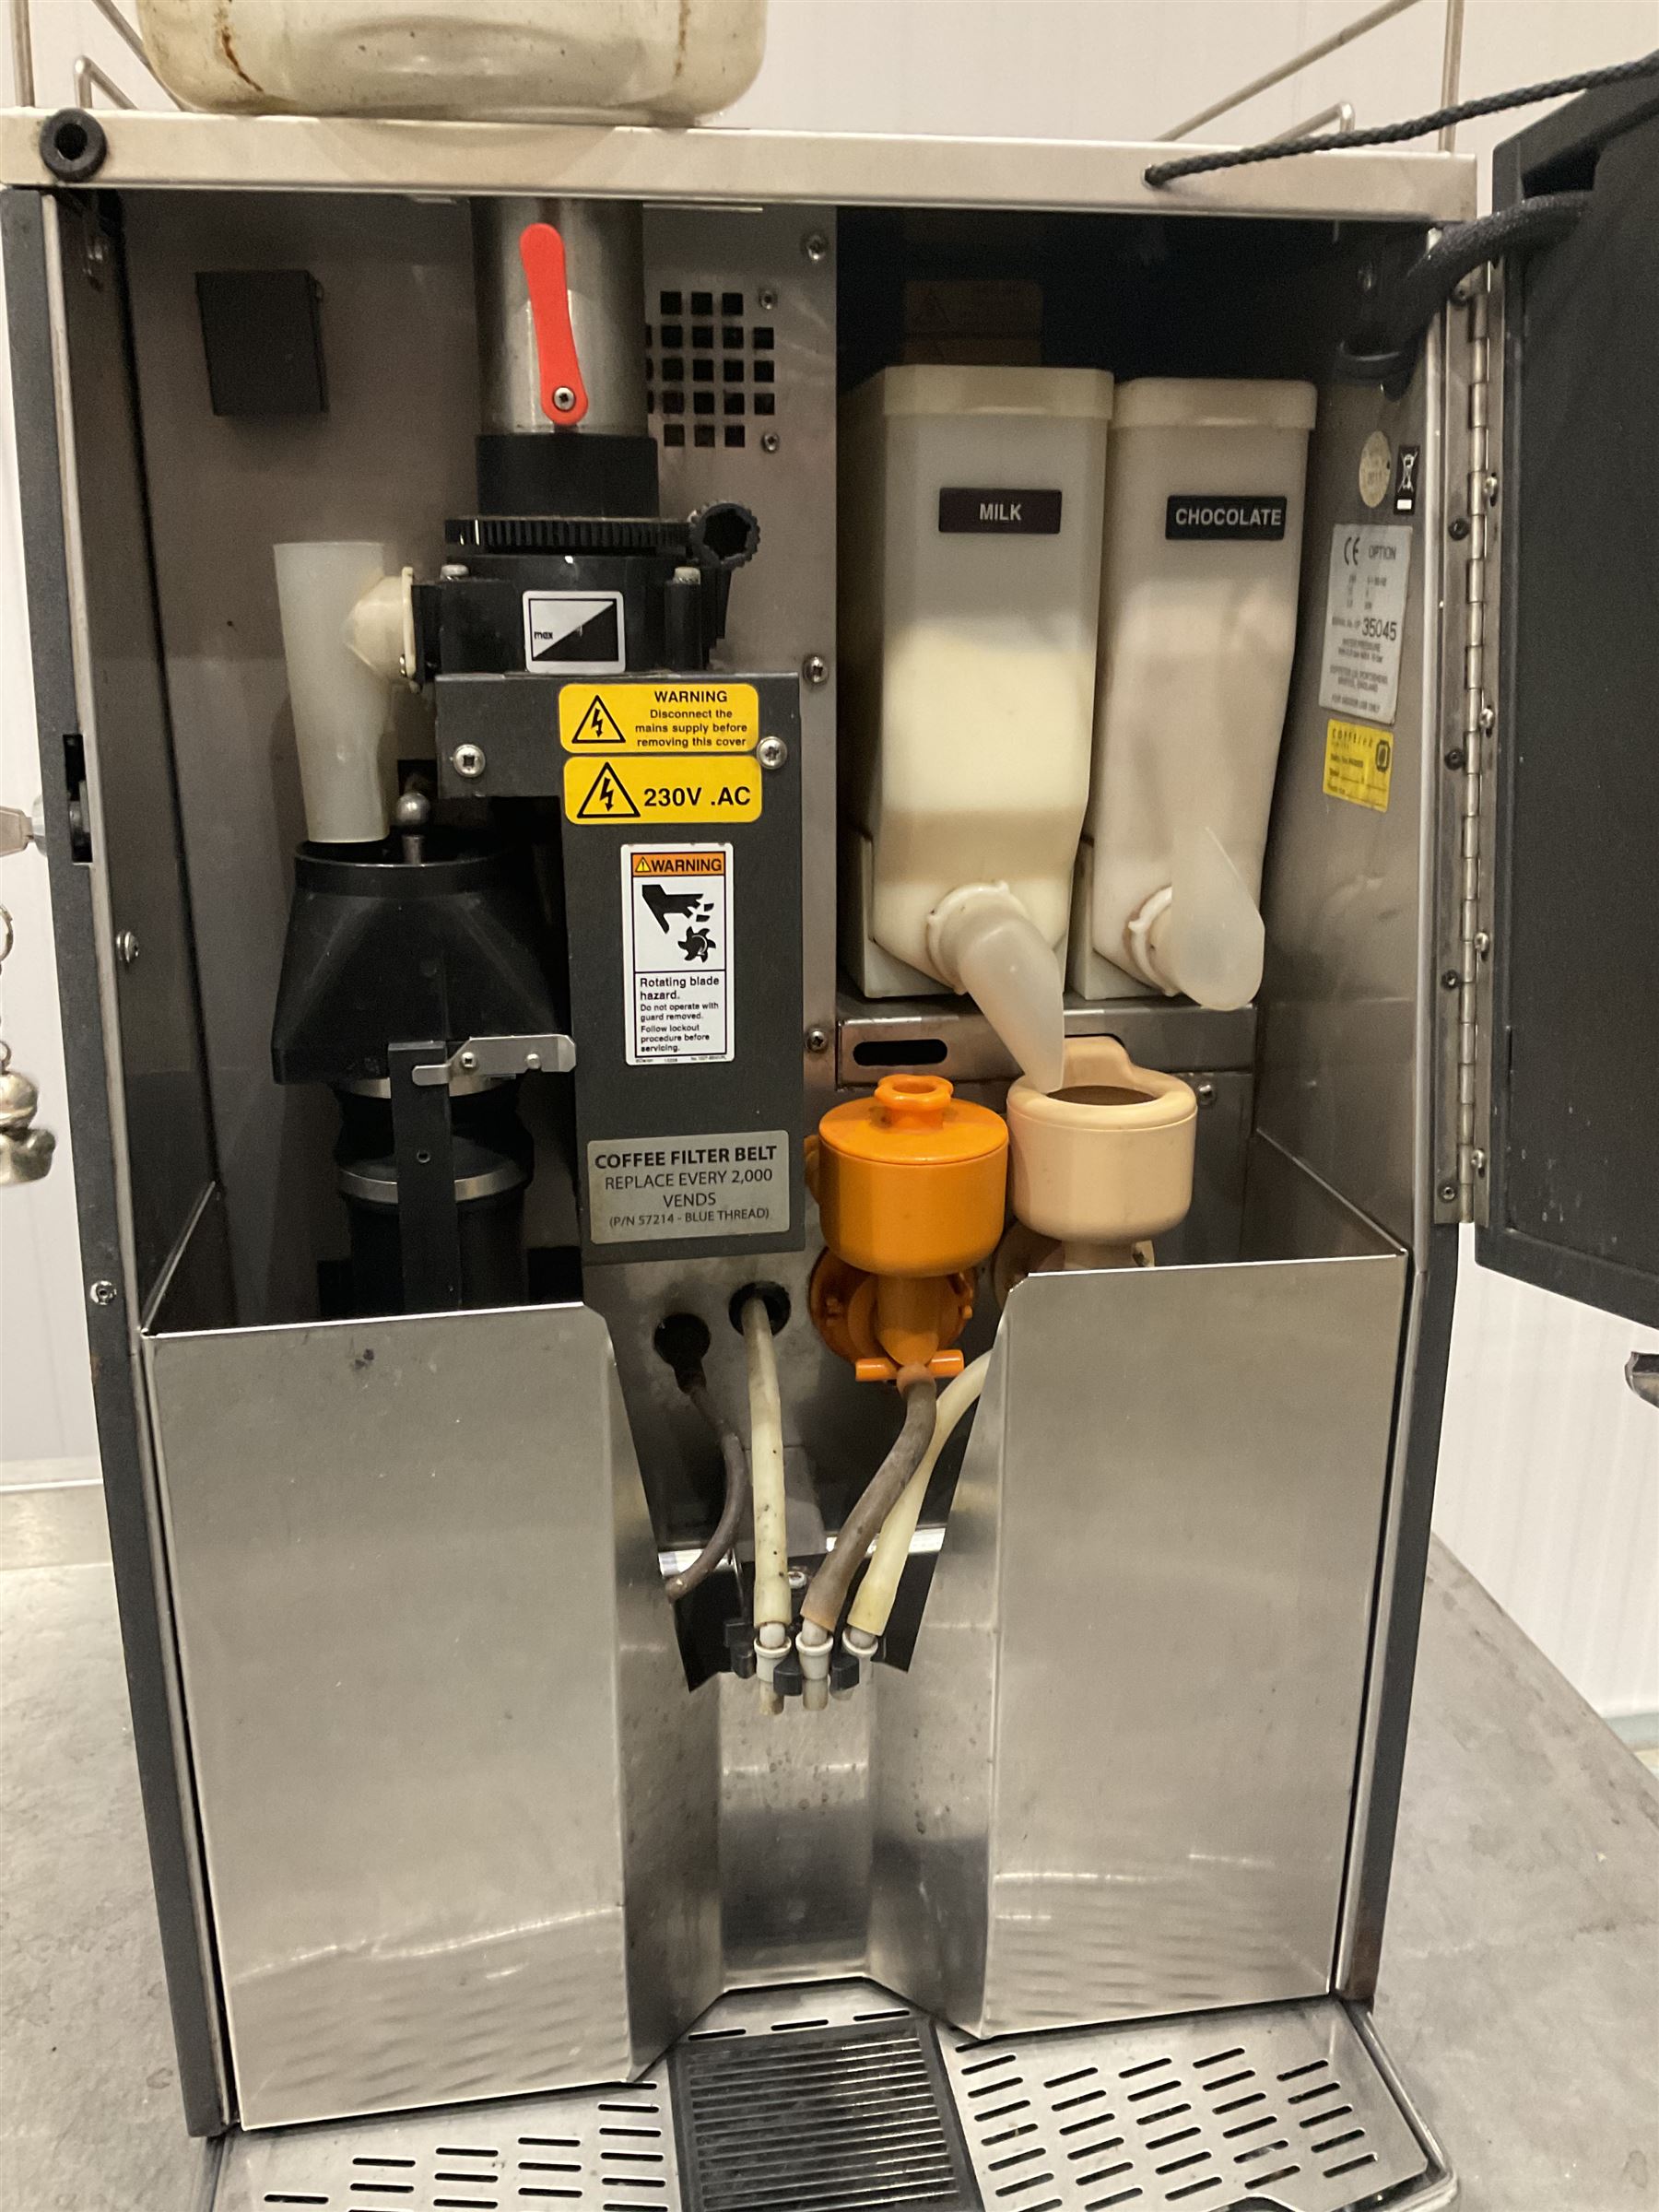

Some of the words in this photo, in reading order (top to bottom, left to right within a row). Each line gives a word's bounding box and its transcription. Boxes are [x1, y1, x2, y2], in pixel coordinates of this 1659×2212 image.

[980, 503, 1022, 521] MILK
[1175, 506, 1282, 526] CHOCOLATE
[534, 630, 554, 641] max
[1362, 617, 1397, 641] 35045
[654, 690, 728, 703] WARNING
[650, 708, 712, 719] Disconnect
[715, 708, 733, 719] the
[635, 723, 669, 733] mains
[672, 724, 709, 735] supply
[712, 723, 747, 733] before
[637, 737, 689, 748] removing
[692, 736, 712, 747] this
[716, 737, 747, 747] cover
[643, 786, 702, 807] 230V
[652, 858, 723, 873] WARNING
[641, 977, 687, 989] Rotating
[690, 975, 720, 986] blade
[641, 990, 680, 1001] hazard.
[653, 1003, 667, 1011] not
[669, 1004, 700, 1012] operate
[641, 1013, 665, 1023] guard
[665, 1012, 703, 1020] removed.
[641, 1025, 667, 1033] Follow
[641, 1035, 682, 1044] procedure
[684, 1033, 710, 1041] before
[641, 1044, 680, 1053] servicing.
[594, 1148, 666, 1170] COFFEE
[670, 1147, 730, 1165] FILTER
[734, 1145, 777, 1162] BELT
[605, 1173, 675, 1191] REPLACE
[678, 1171, 728, 1187] EVERY
[731, 1168, 773, 1185] 2,000
[663, 1192, 716, 1208] VENDS
[609, 1213, 636, 1229] (P/N
[638, 1211, 675, 1226] 57214
[685, 1210, 714, 1224] BLUE
[717, 1207, 770, 1223] THREAD)
